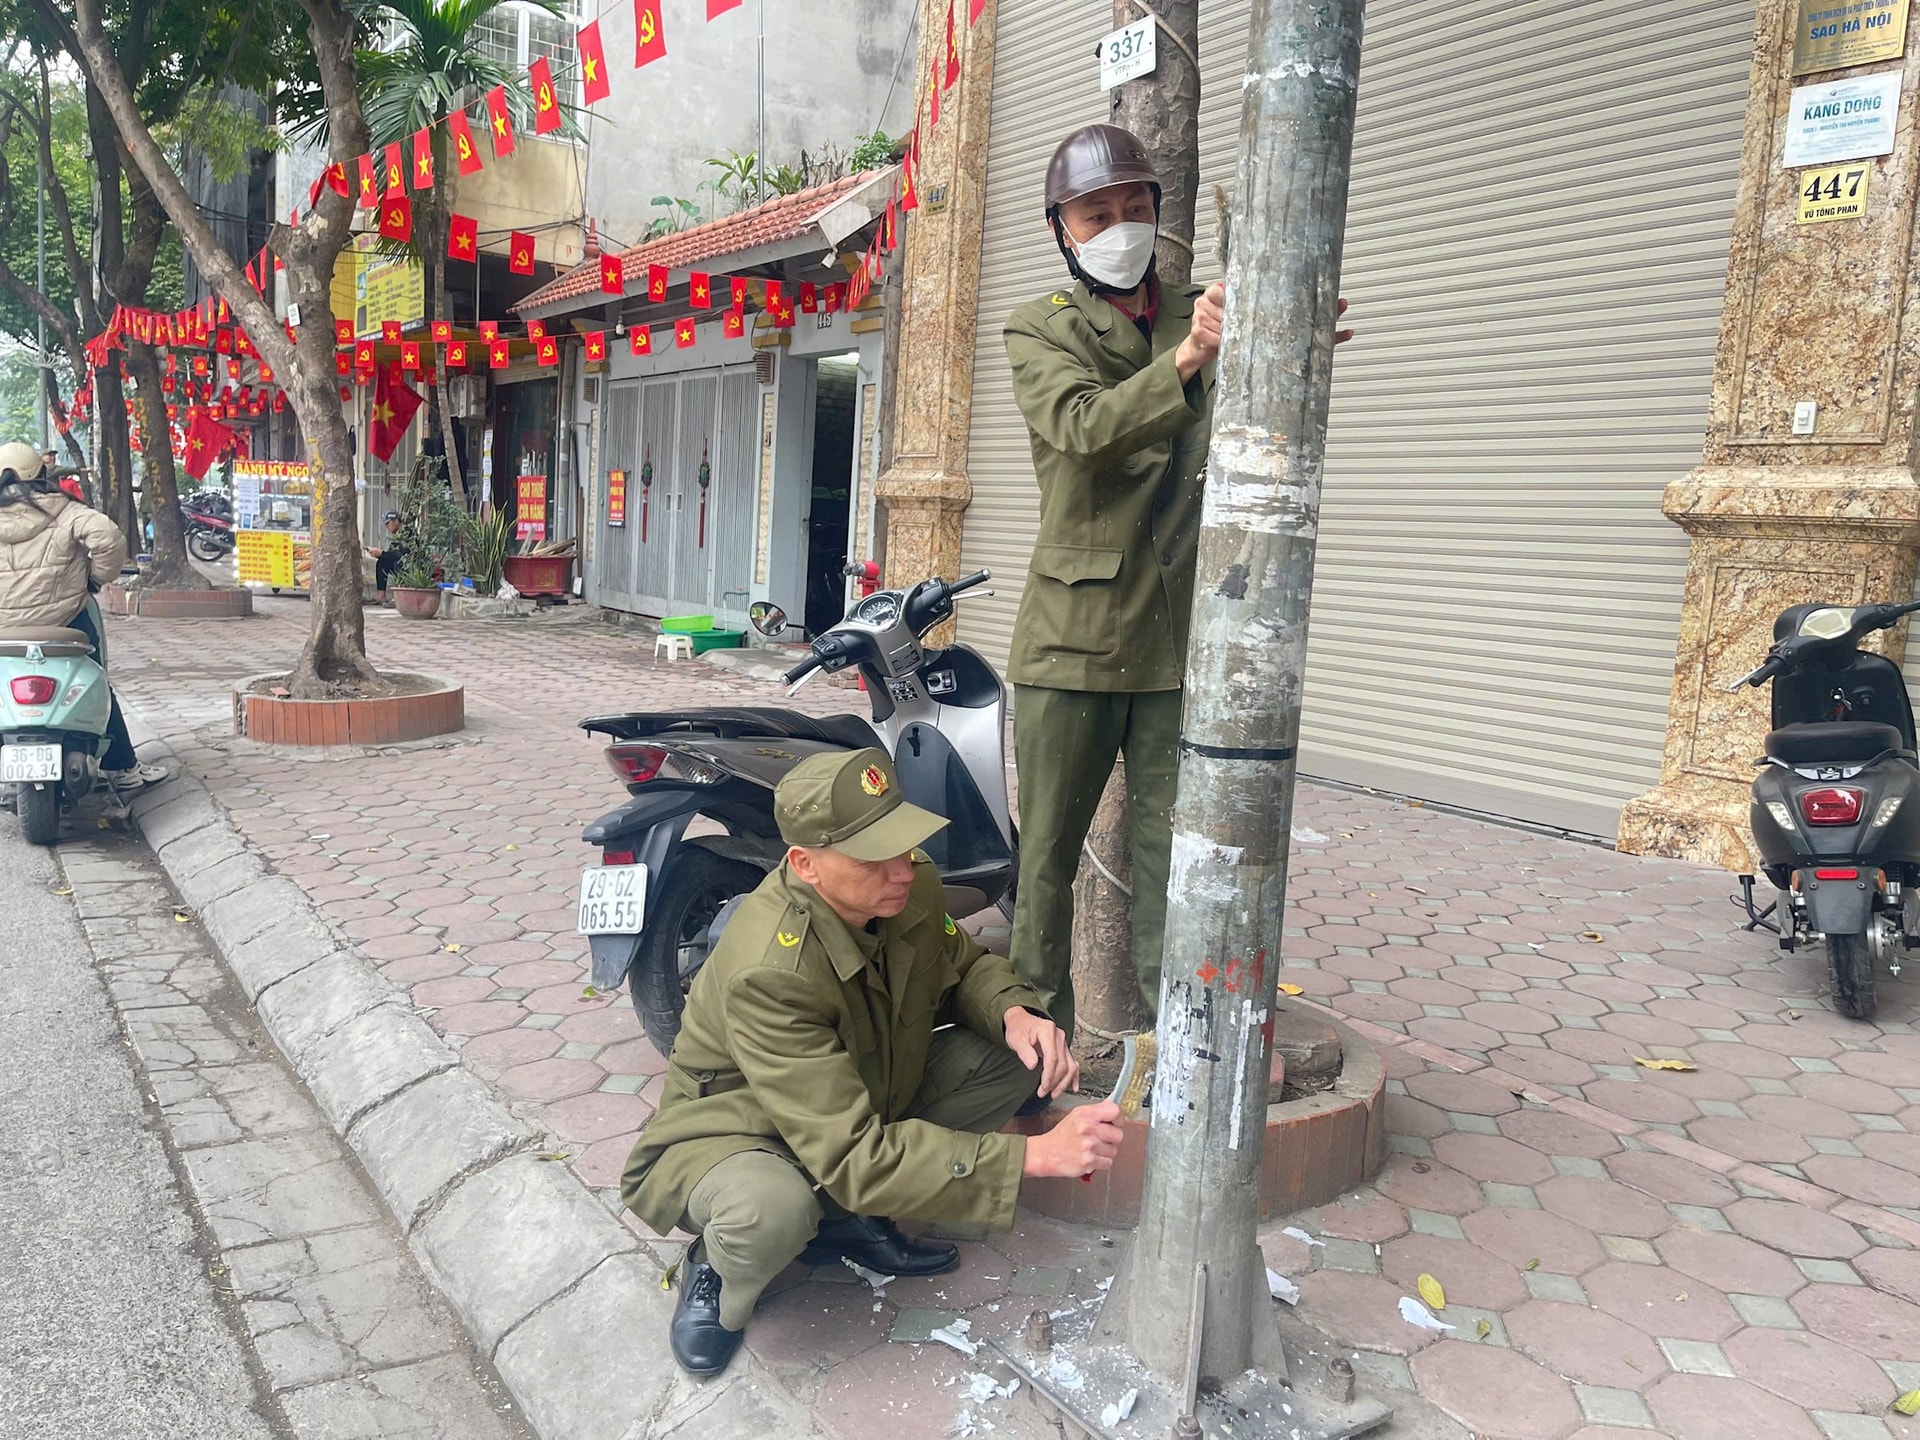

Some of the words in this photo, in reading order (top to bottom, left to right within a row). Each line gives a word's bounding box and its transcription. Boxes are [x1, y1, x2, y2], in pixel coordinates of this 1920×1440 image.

[1810, 24, 1837, 39] SAO
[1842, 17, 1860, 33] HÀ
[1866, 11, 1892, 29] NỘI
[1110, 30, 1145, 63] 337
[1804, 102, 1841, 120] KANG
[928, 186, 947, 203] 447
[1803, 170, 1864, 202] 447
[1837, 204, 1858, 215] PHAN
[818, 312, 832, 328] 445
[6, 763, 58, 780] 002.34
[581, 901, 639, 930] 065.55
